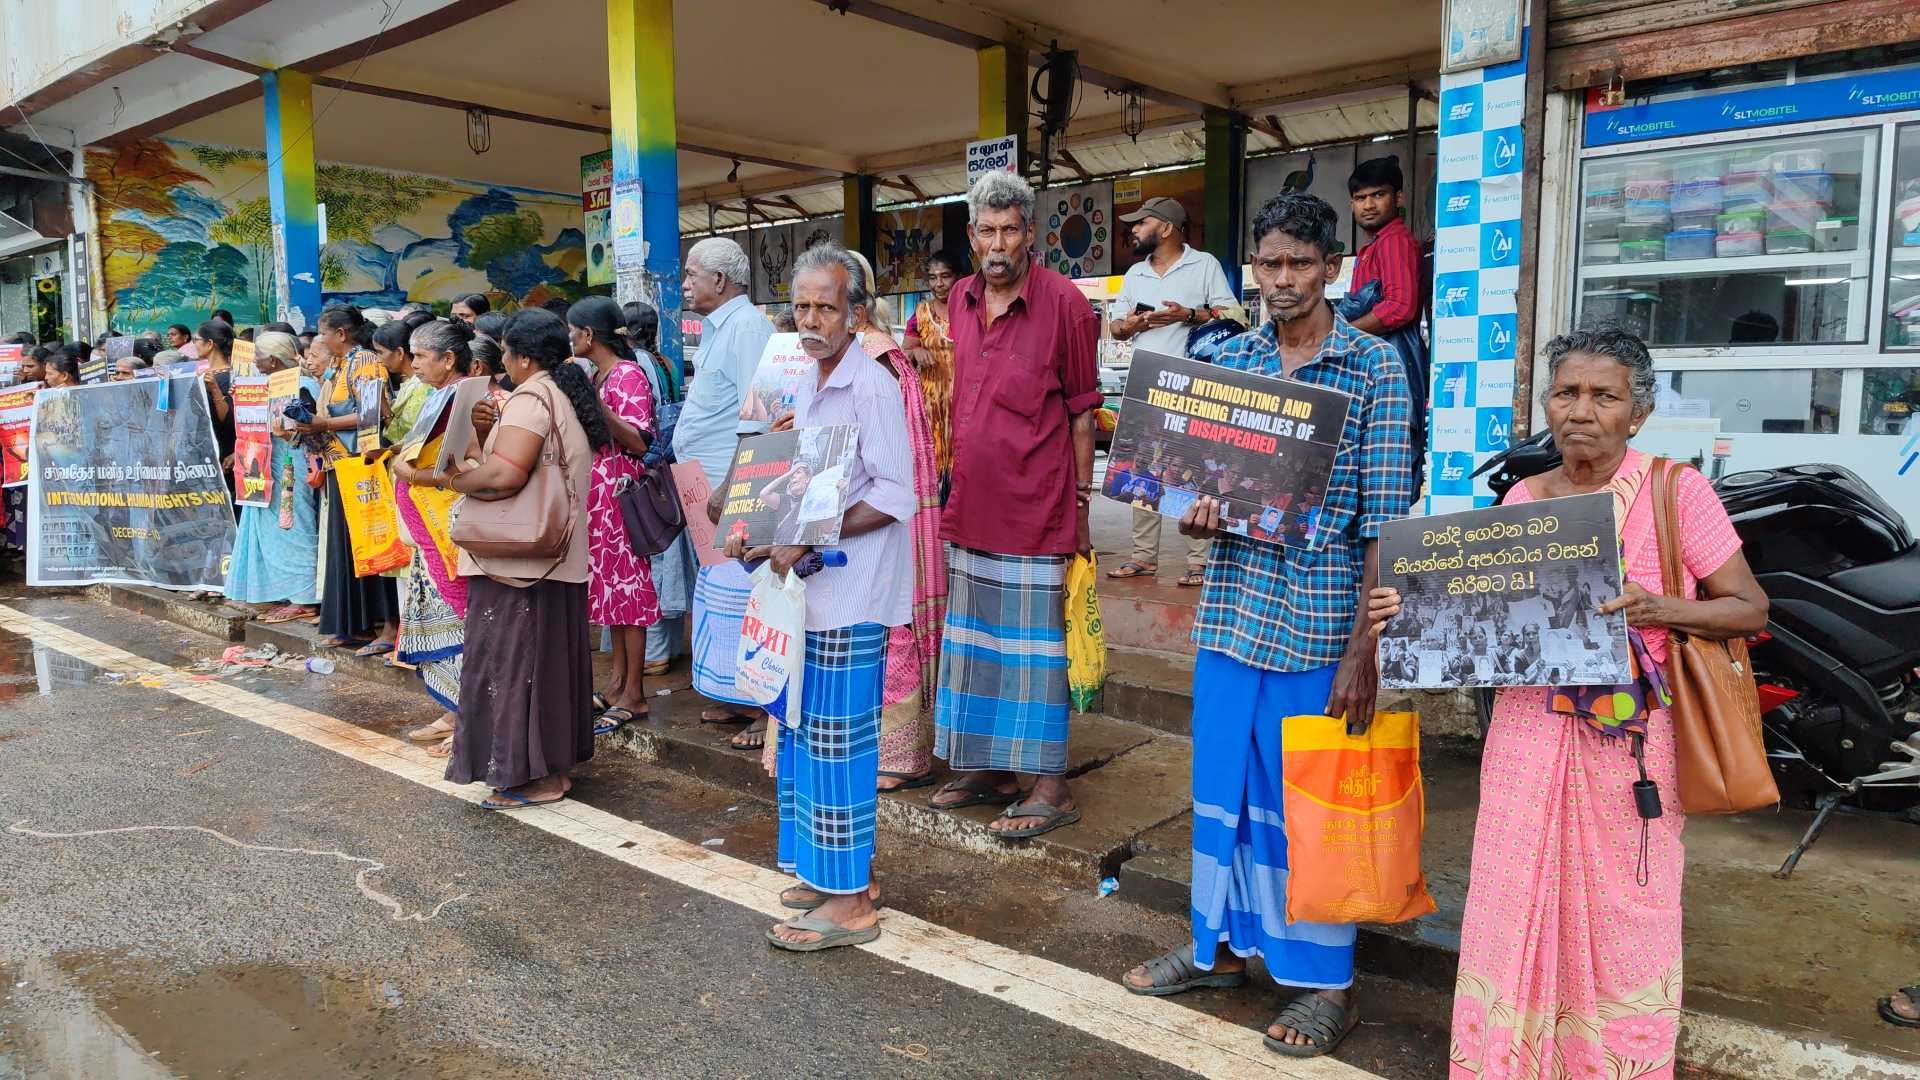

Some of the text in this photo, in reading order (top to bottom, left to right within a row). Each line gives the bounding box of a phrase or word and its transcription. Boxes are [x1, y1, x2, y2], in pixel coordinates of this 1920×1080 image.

[1495, 100, 1521, 110] MOBITE
[1450, 154, 1479, 163] MOBITEL
[590, 191, 610, 208] SAL
[1447, 246, 1476, 254] MOBITEL
[1490, 288, 1516, 296] MOBITE
[1157, 370, 1313, 420] STOP INTIMIDATING AND
[1147, 388, 1316, 441] THREATENING FAMILIES OF
[1163, 412, 1188, 434] THE
[1187, 419, 1277, 455] DISAPPEARED
[738, 449, 754, 466] CAN
[44, 461, 95, 485] சர்வதேச
[98, 461, 124, 482] மனித
[126, 460, 171, 481] உரிமைகள்
[734, 460, 791, 481] PERPETRATORS
[729, 481, 751, 499] BRING
[47, 491, 226, 509] INTERNATIONAL HUMAN RIGHTS DAY
[724, 498, 754, 516] JUSTICE
[1422, 516, 1559, 548] වන්දි ගෙවන බව
[1393, 536, 1600, 575] කියන්නේ අපරාධය වසන්
[1447, 575, 1506, 595] කිරීමට
[741, 615, 792, 657] RIGHT
[761, 657, 785, 675] Choice
[1323, 817, 1356, 832] நாடு
[1379, 833, 1398, 841] RICE
